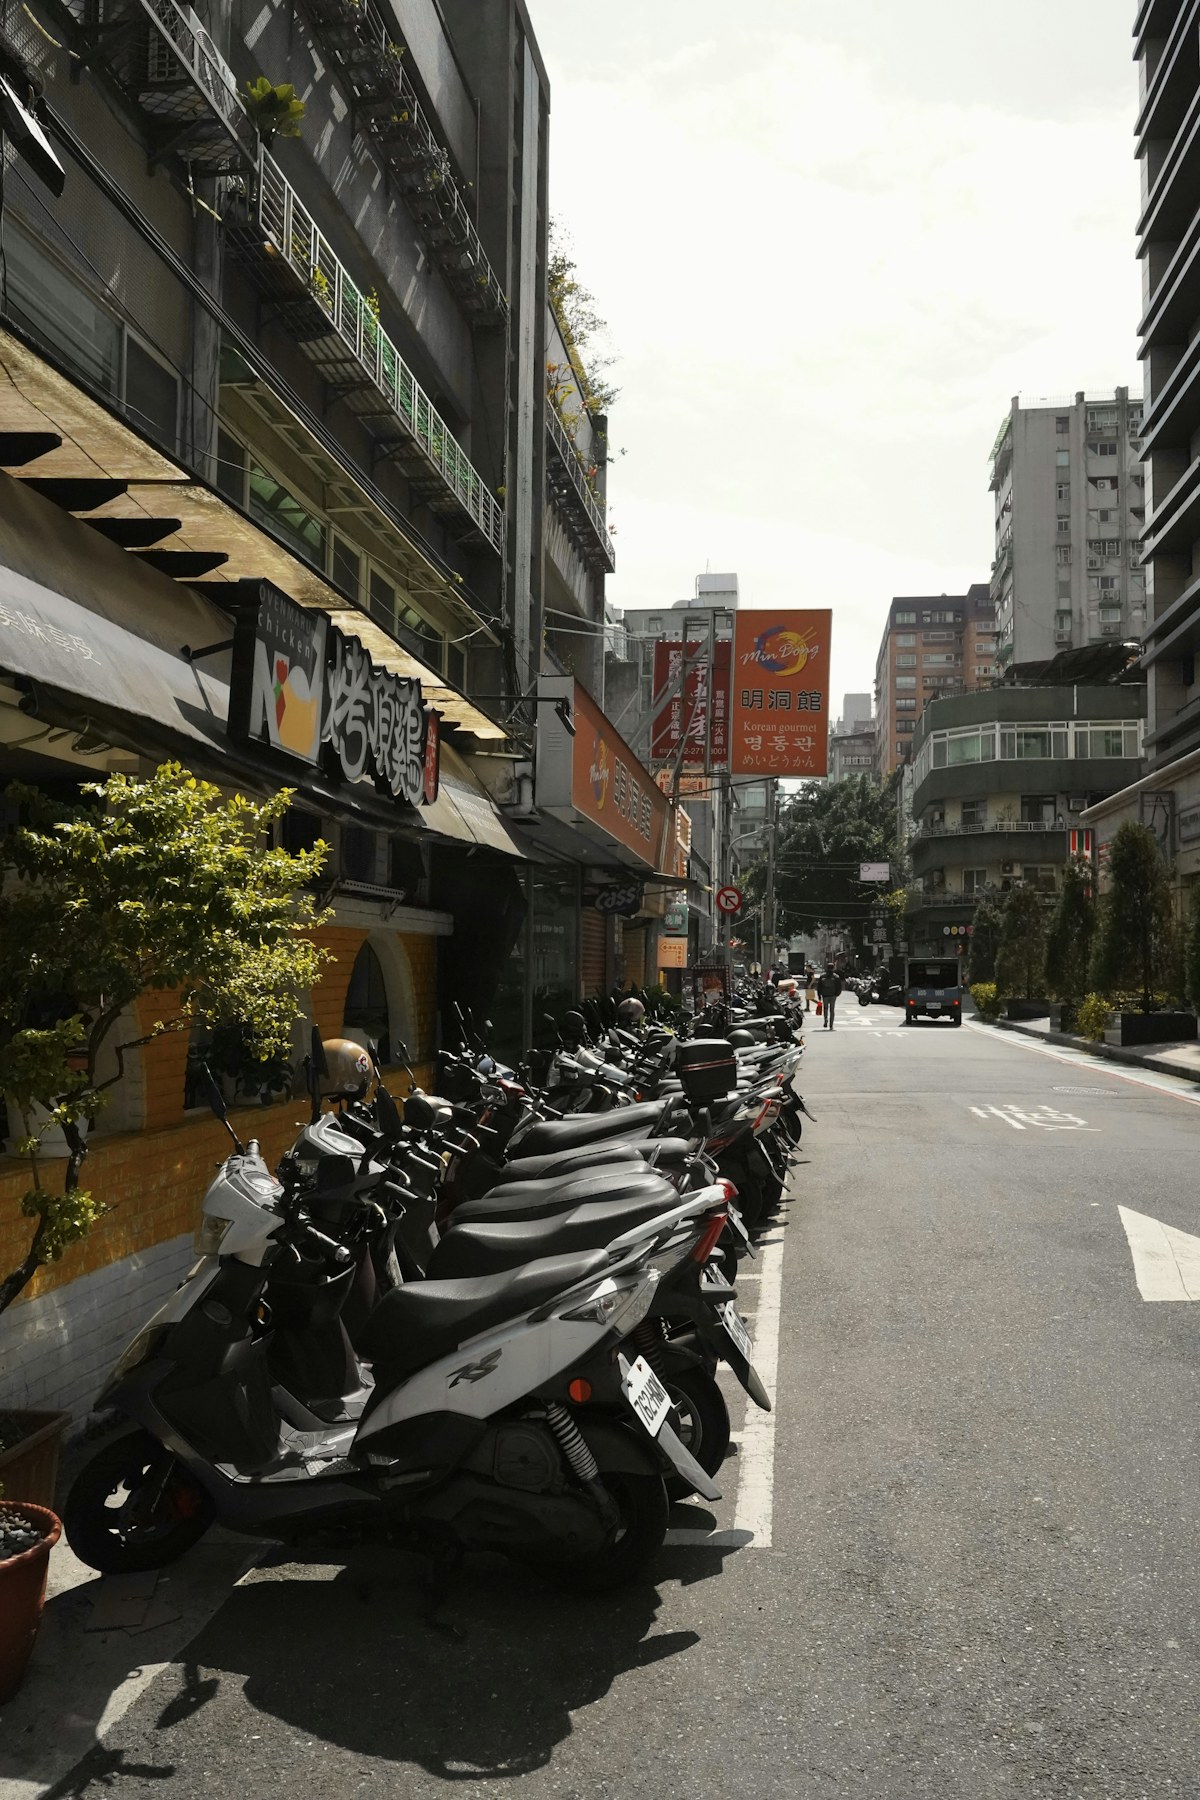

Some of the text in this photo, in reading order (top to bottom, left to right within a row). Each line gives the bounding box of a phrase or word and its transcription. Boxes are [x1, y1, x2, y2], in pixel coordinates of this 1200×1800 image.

[258, 612, 311, 658] chicken
[740, 643, 820, 665] Min Dong
[741, 689, 823, 712] 明洞館
[743, 721, 817, 735] Korean gourmet
[744, 735, 817, 752] 명동관
[967, 1103, 1102, 1132] 慢
